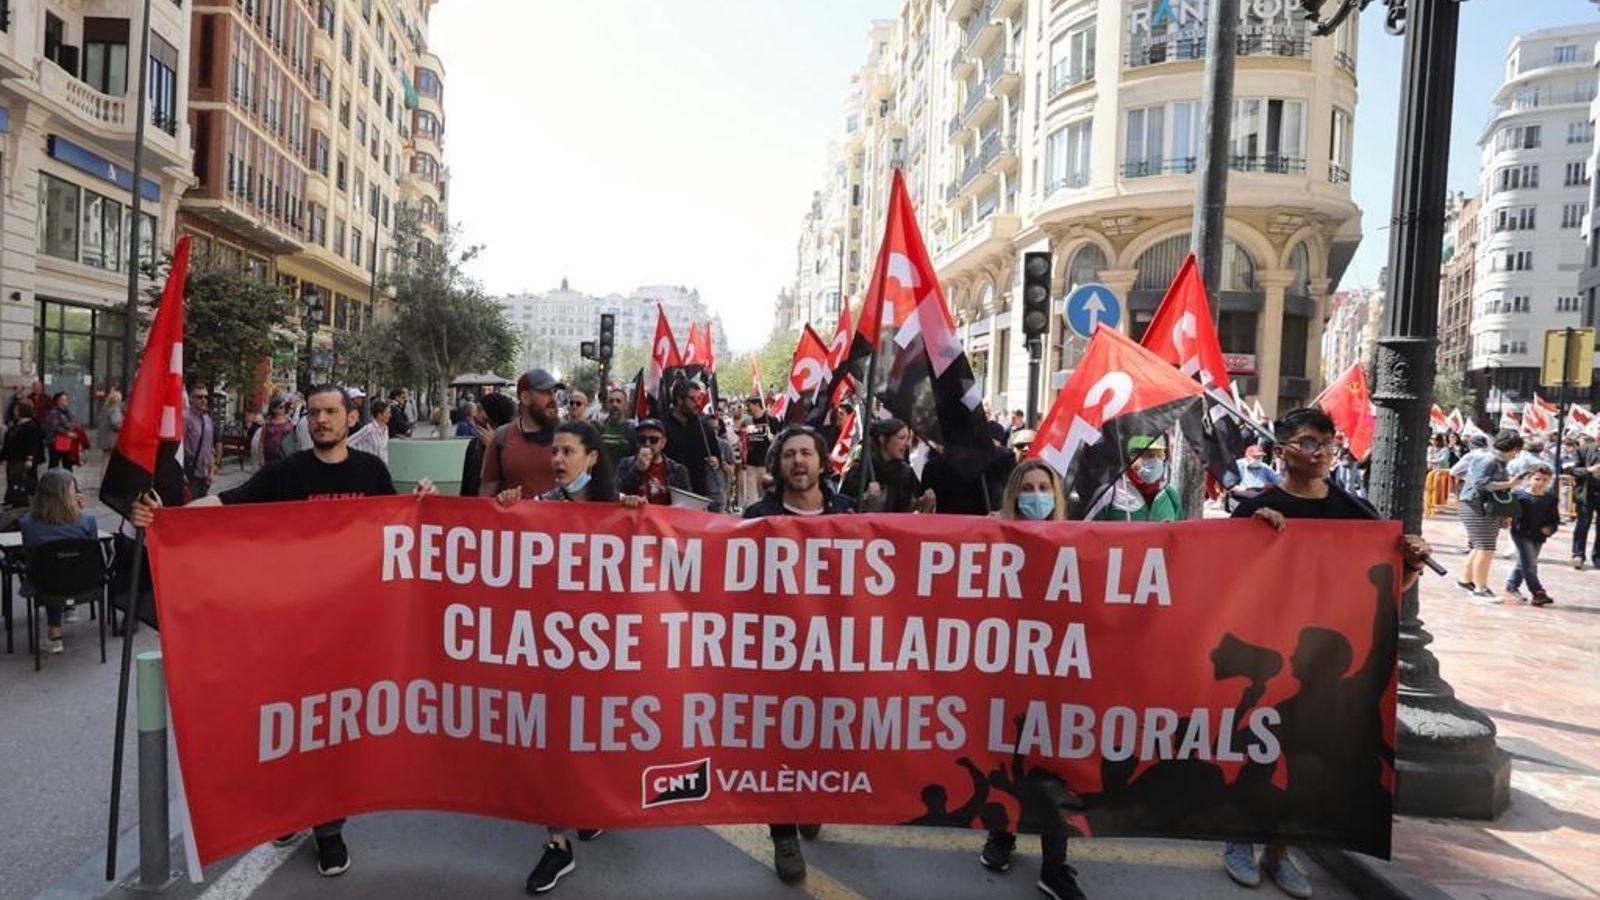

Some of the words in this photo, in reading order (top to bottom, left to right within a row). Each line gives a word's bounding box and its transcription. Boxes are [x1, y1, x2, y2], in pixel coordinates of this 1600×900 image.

[380, 524, 703, 593] RECUPEREM
[723, 537, 896, 597] DRETS
[916, 541, 1026, 600] PER
[1045, 545, 1083, 603] A
[1104, 546, 1172, 607] LA
[443, 604, 642, 672] CLASSE
[659, 611, 1092, 680] TREBALLADORA
[259, 679, 547, 763] DEROGUEM
[569, 695, 662, 752] LES
[682, 692, 967, 753] REFORMES
[987, 697, 1281, 764] LABORALS
[653, 772, 700, 793] CNT
[715, 764, 873, 793] VALÈNCIA
